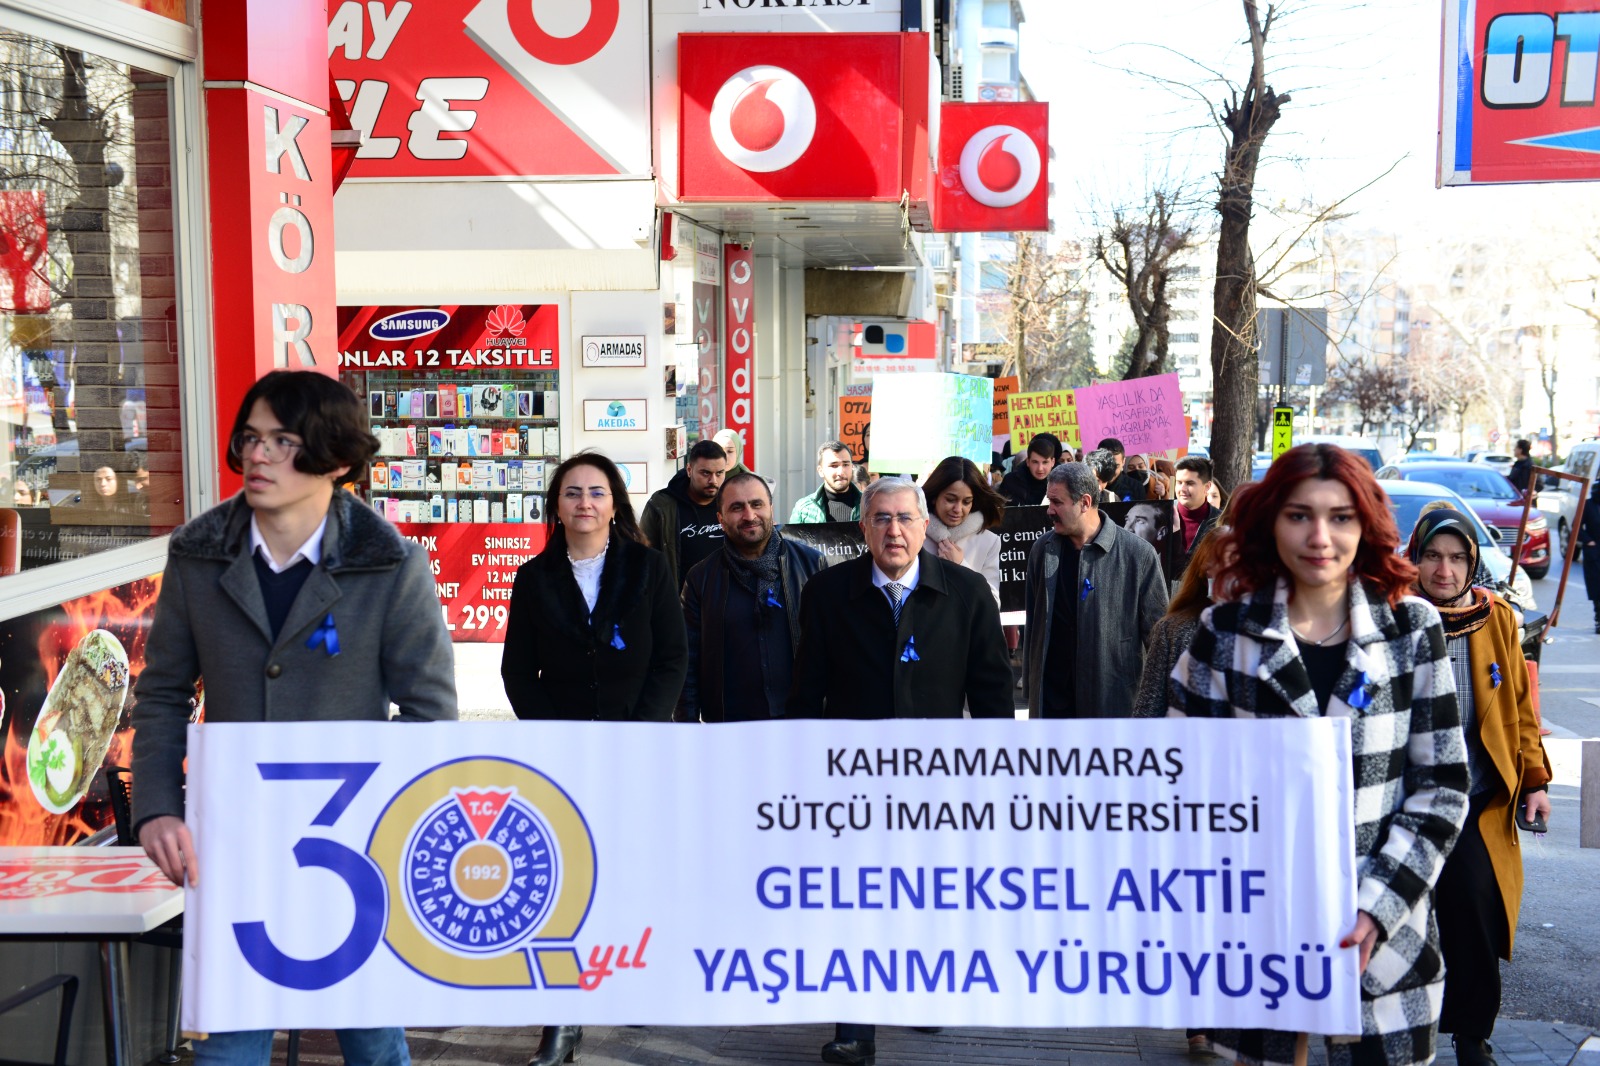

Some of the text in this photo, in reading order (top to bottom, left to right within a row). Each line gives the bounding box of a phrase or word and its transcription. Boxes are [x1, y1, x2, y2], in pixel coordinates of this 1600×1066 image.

[380, 319, 440, 331] SAMSUNG
[486, 337, 527, 347] HUAWEI
[414, 349, 440, 366] 12
[445, 345, 553, 366] TAKSİTLE
[600, 342, 642, 359] ARMADAŞ
[1149, 387, 1166, 402] DA
[1011, 396, 1034, 411] HER
[1013, 413, 1045, 430] ADIM
[484, 537, 531, 549] SINIRSIZ
[471, 554, 486, 566] EV
[487, 571, 499, 583] 12
[827, 748, 1183, 785] KAHRAMANMARAŞ
[469, 801, 498, 816] T.C.
[757, 794, 1259, 838] SÜTÇÜ İMAM ÜNİVERSİTESİ
[432, 825, 528, 924] KAHRAMANMARAŞ
[462, 865, 501, 881] 1992
[756, 857, 1266, 914] GELENEKSEL AKTİF
[578, 927, 652, 990] yıl
[694, 938, 1332, 1011] YAŞLANMA YÜRÜYÜŞÜ
